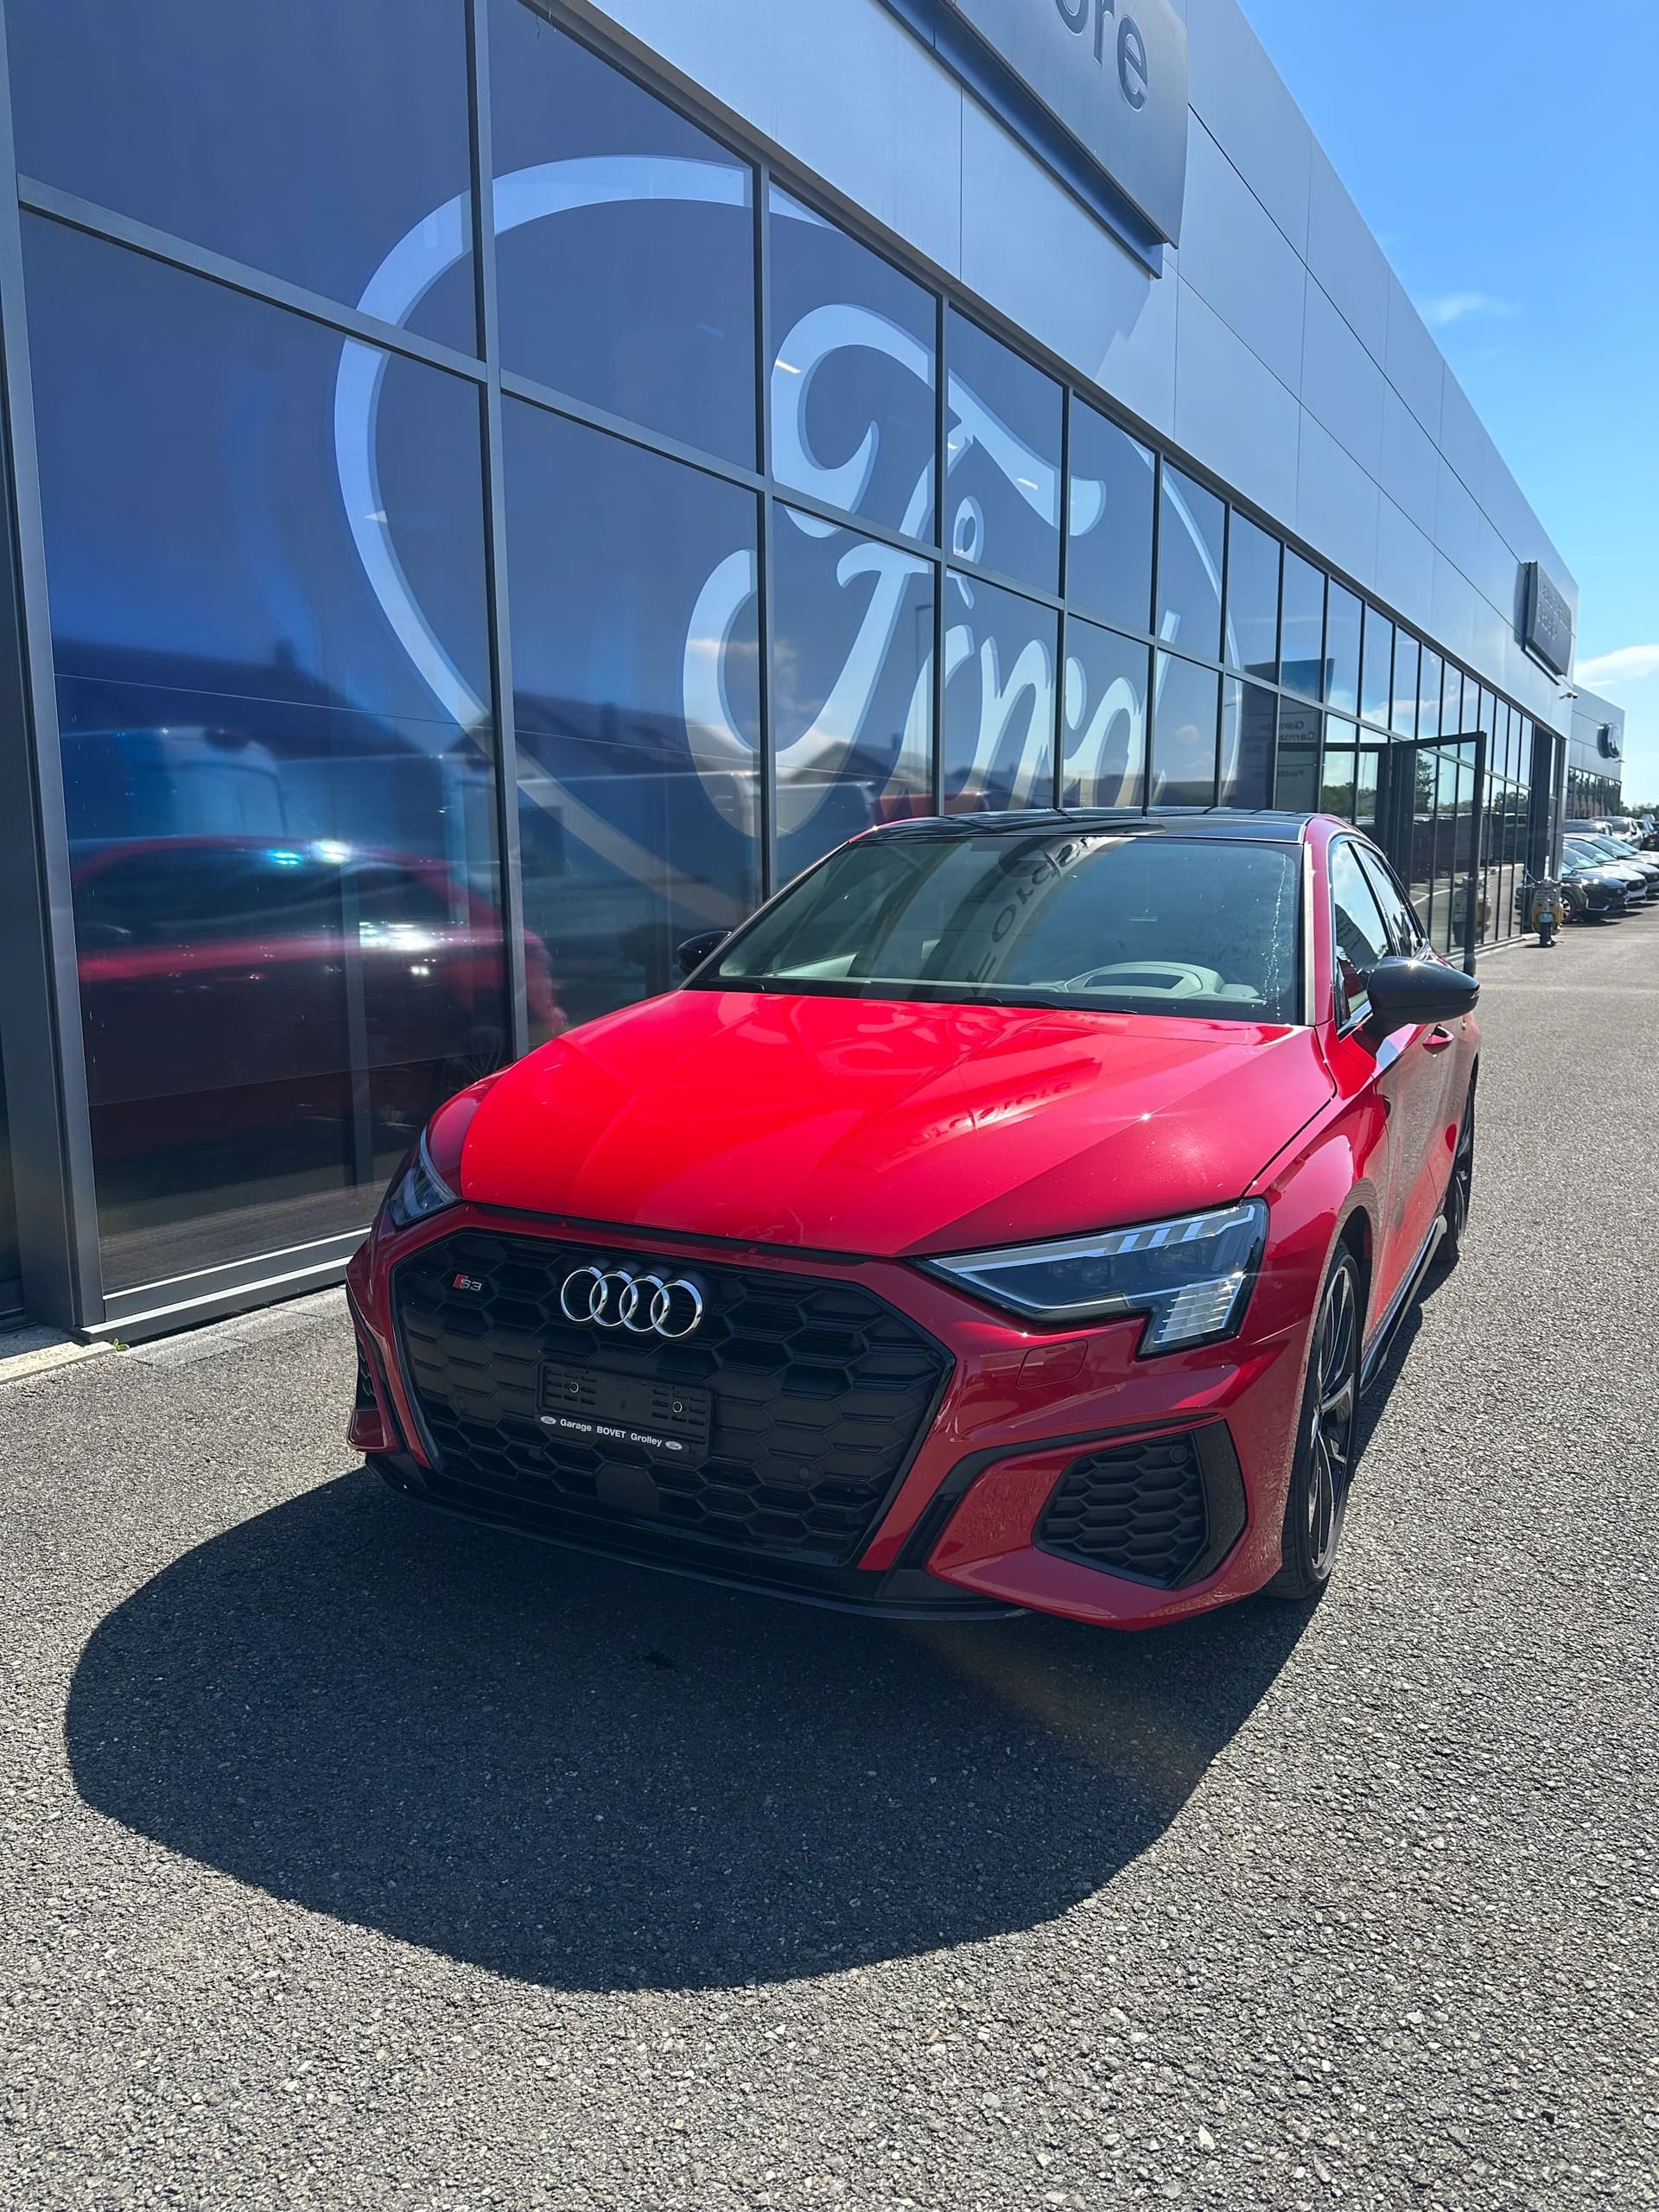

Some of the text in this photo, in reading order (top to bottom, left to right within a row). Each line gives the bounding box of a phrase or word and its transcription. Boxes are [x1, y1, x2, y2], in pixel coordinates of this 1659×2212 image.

[683, 303, 1179, 838] Ford
[560, 1419, 592, 1432] Garage
[596, 1426, 627, 1439] BOVET
[630, 1433, 663, 1447] Grolley
